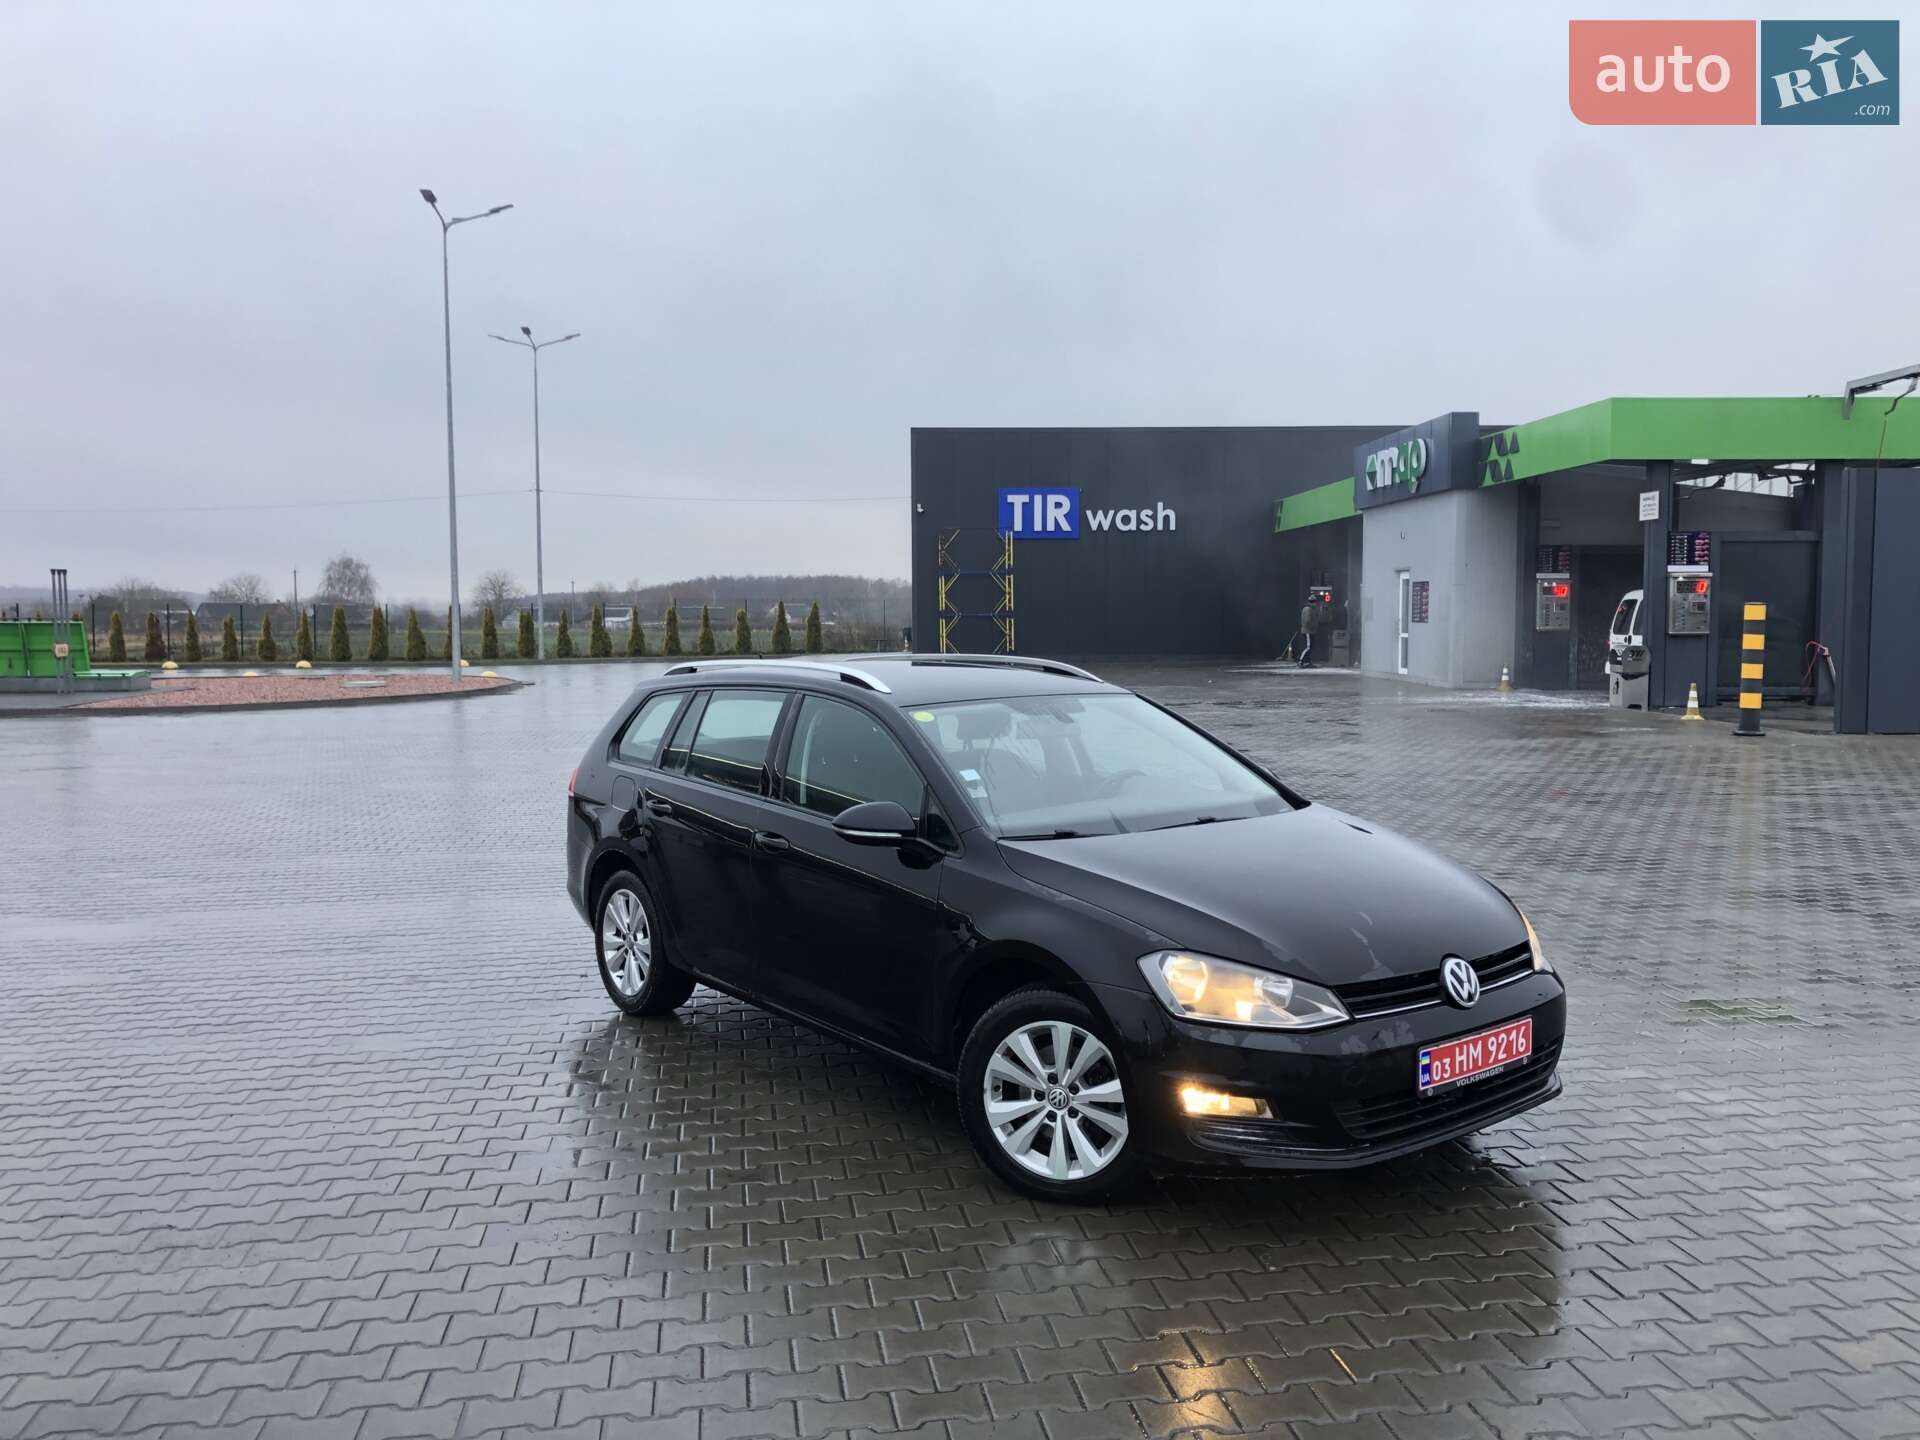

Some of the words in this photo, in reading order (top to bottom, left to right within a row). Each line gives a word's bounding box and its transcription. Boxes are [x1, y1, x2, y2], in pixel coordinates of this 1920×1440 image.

[1007, 494, 1072, 532] TIR
[1085, 502, 1176, 532] wash
[1432, 1057, 1451, 1081] 03
[1455, 1040, 1482, 1074] HM
[1488, 1026, 1526, 1064] 9216
[1421, 1073, 1431, 1083] UA
[1456, 1065, 1504, 1087] VOLKSWAGEN
